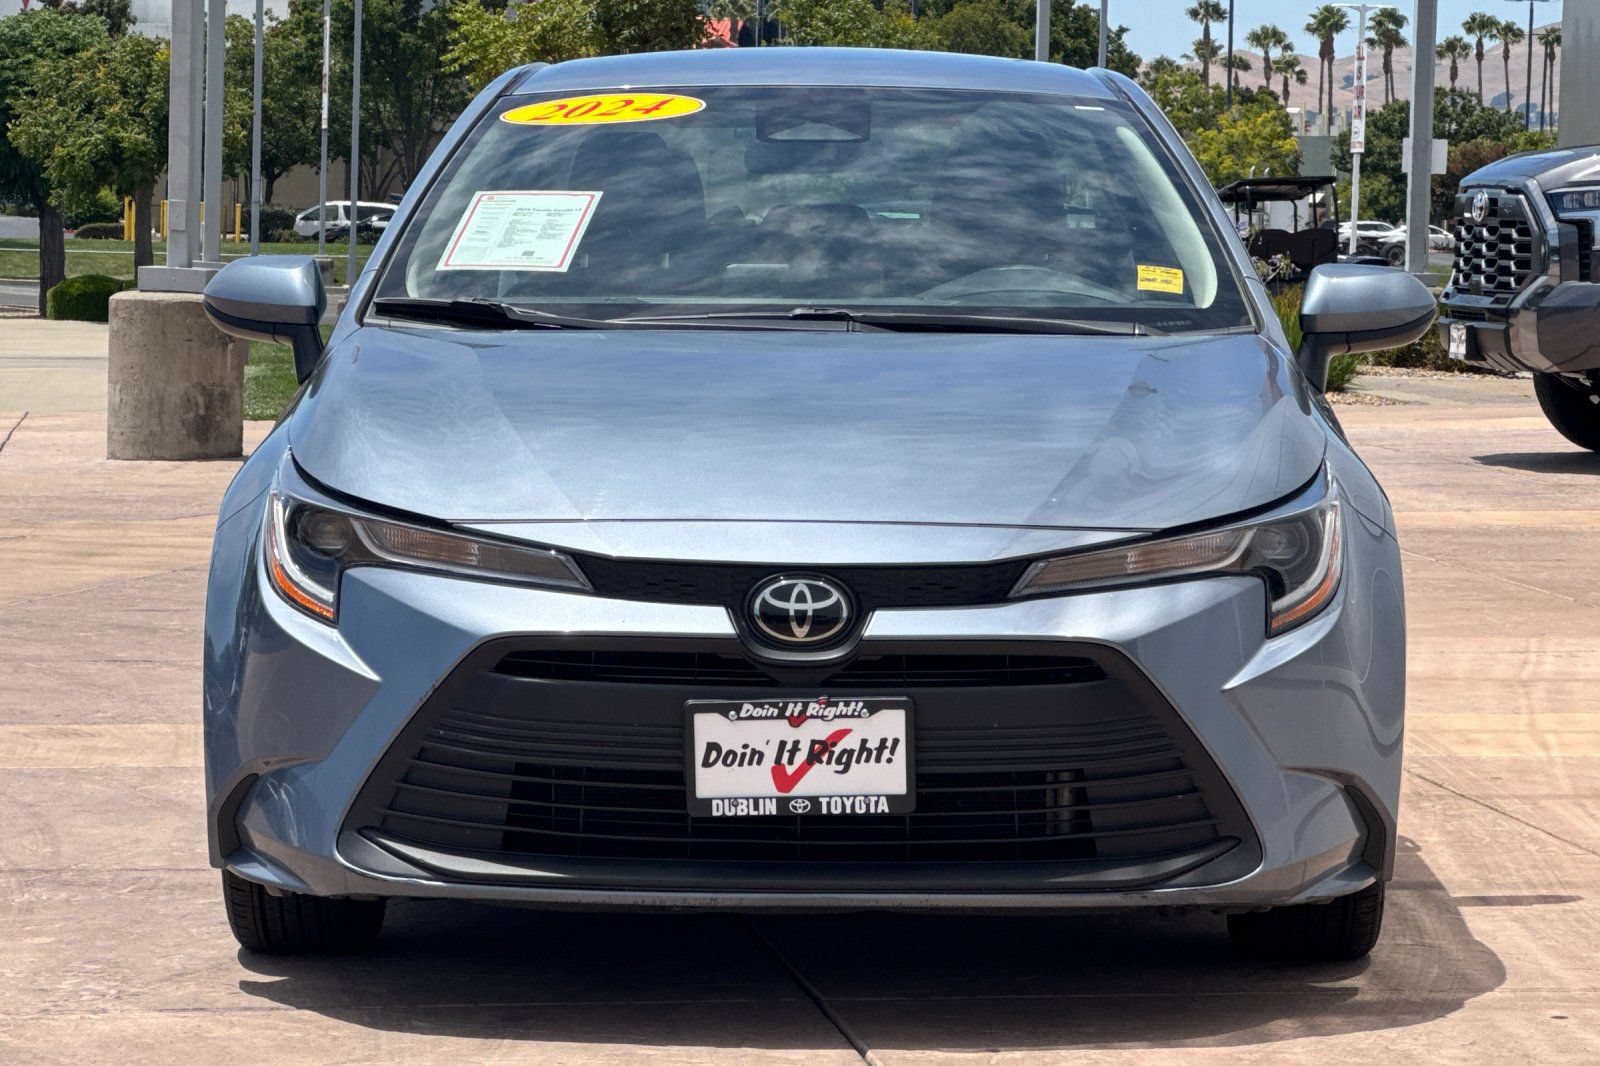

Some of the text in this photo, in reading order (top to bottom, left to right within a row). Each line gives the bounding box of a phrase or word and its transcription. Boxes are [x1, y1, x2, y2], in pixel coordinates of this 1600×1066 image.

[526, 97, 676, 121] 2024
[739, 701, 864, 721] Doin' It Right!
[701, 737, 901, 775] Doin' It Right!
[711, 796, 890, 816] DUBLIN TOYOTA
